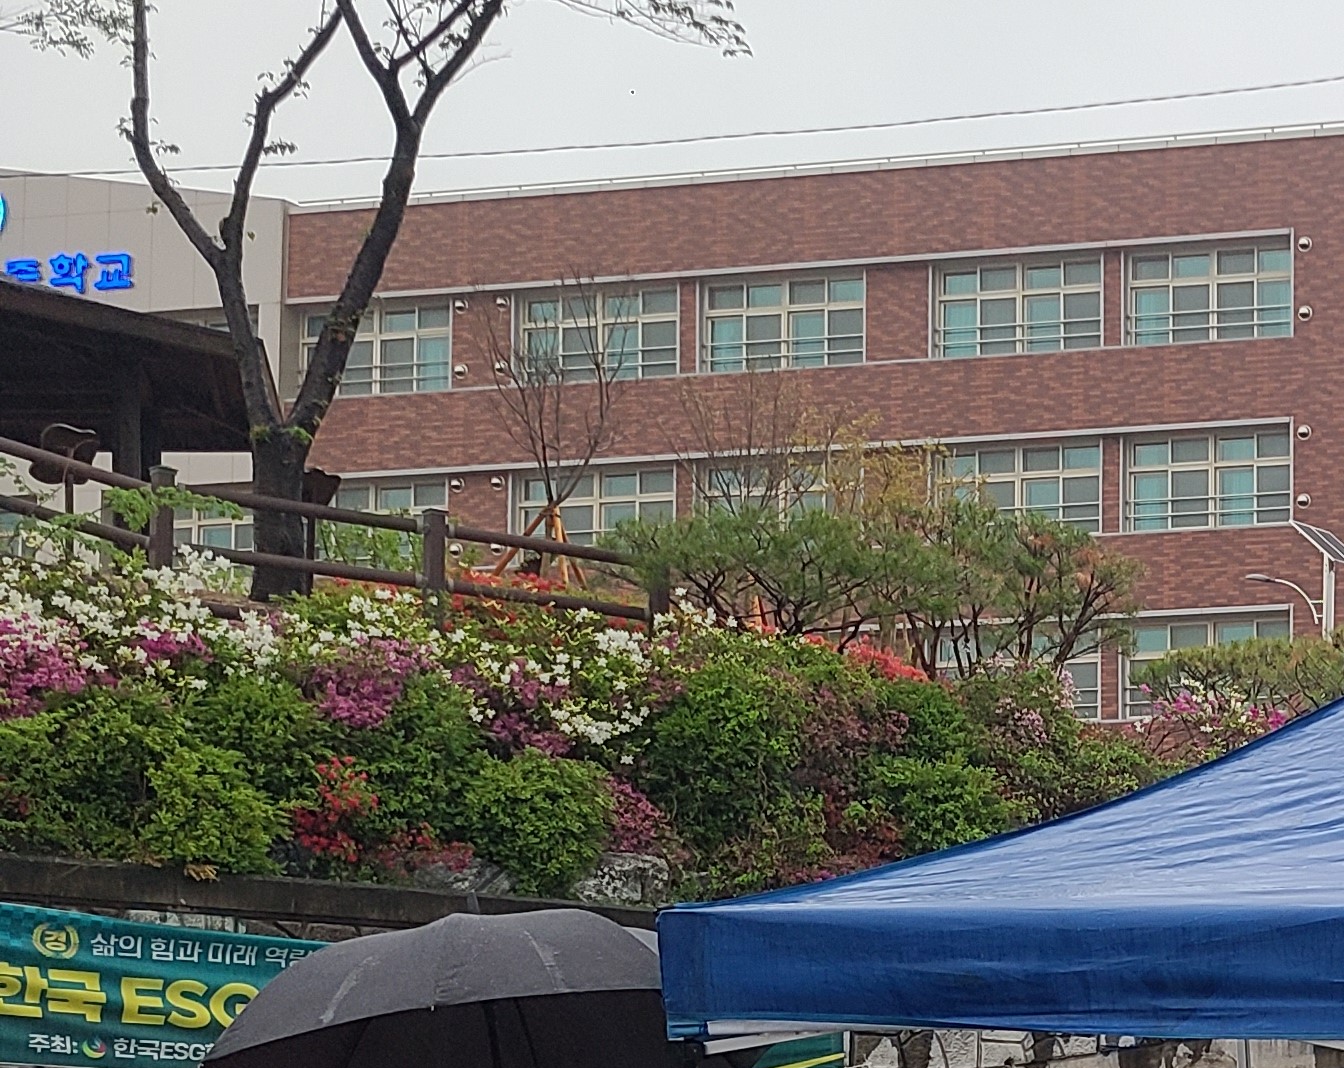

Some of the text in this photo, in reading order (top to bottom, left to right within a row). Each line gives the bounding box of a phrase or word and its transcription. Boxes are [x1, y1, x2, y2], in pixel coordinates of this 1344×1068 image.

[90, 933, 142, 958] 삶의
[151, 937, 203, 962] 힘과
[208, 943, 258, 966] 미래
[0, 961, 259, 1029] 한국 ESG
[28, 1033, 214, 1061] 주최: 한국ESG
